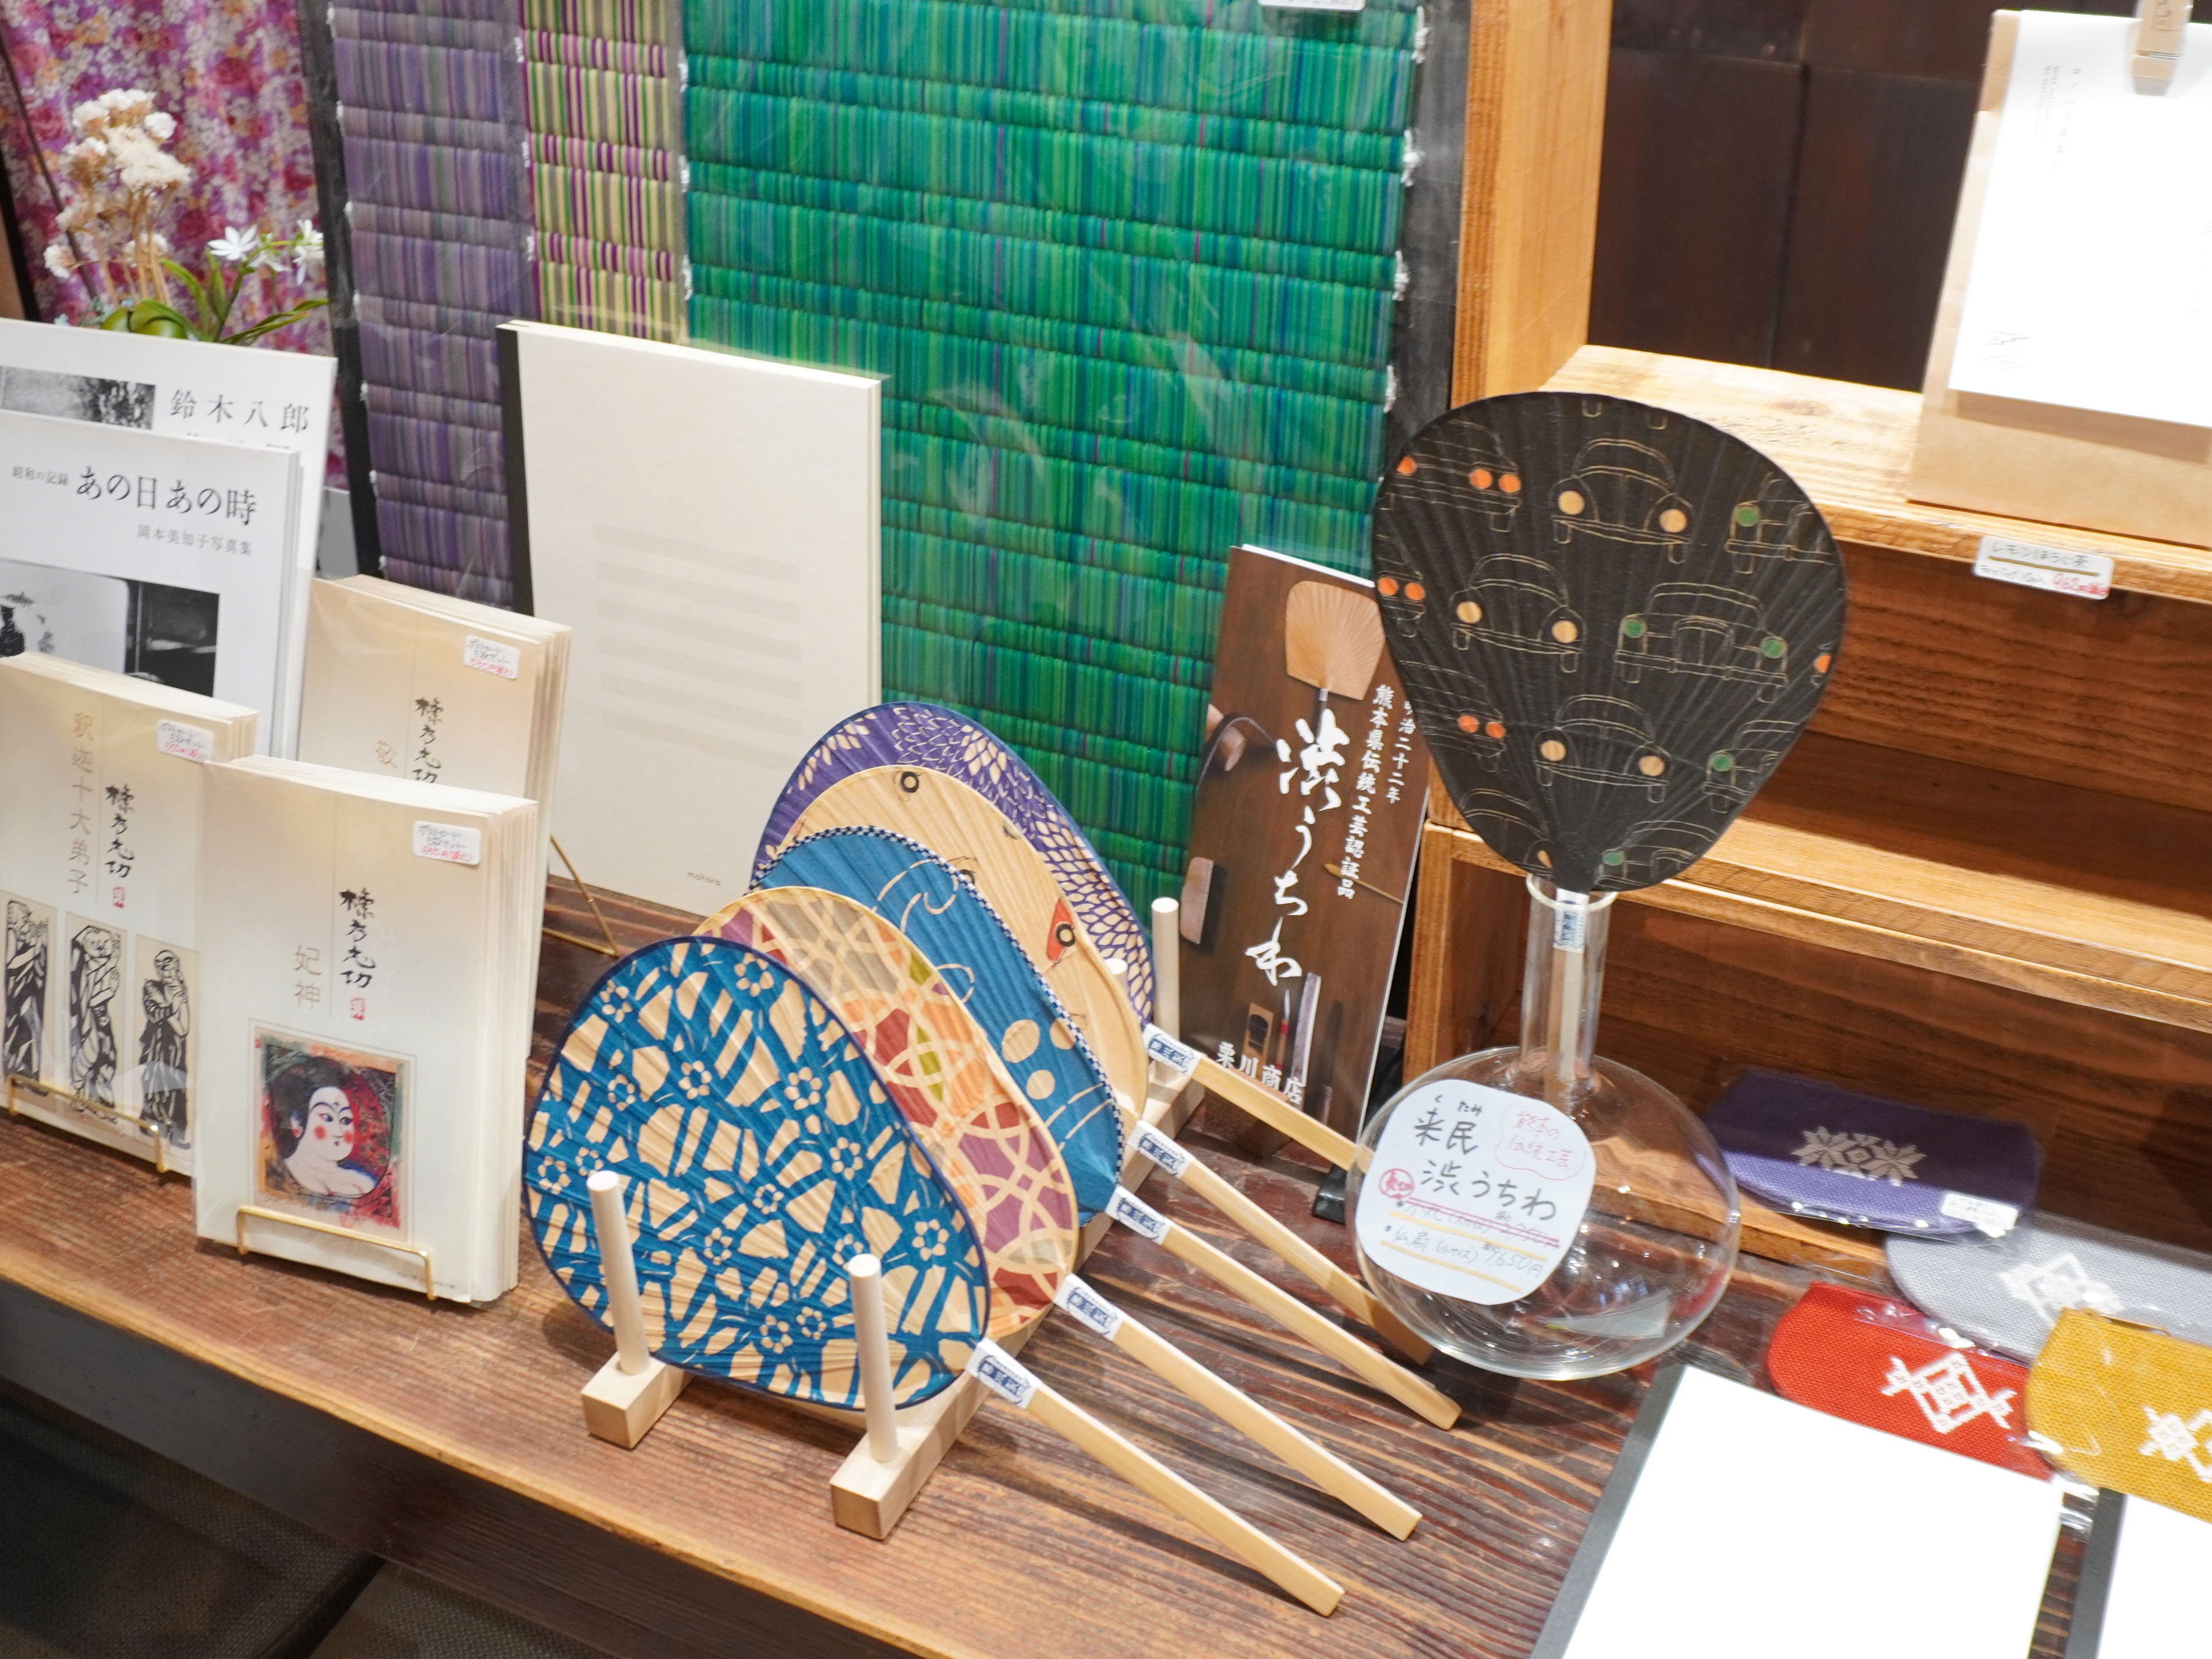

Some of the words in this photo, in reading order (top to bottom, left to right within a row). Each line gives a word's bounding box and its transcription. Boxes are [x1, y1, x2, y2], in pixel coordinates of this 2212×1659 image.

[171, 389, 309, 433] 鈴木八郎
[76, 465, 257, 526] あの日あの時
[1337, 684, 1394, 900] 熊本県伝統工芸認証品
[1245, 708, 1351, 986] 渋うちわ
[294, 945, 322, 1011] 妃神
[1216, 1041, 1303, 1105] 栗川商店
[1414, 1108, 1478, 1155] 来民
[1421, 1160, 1557, 1222] 渋うちわ
